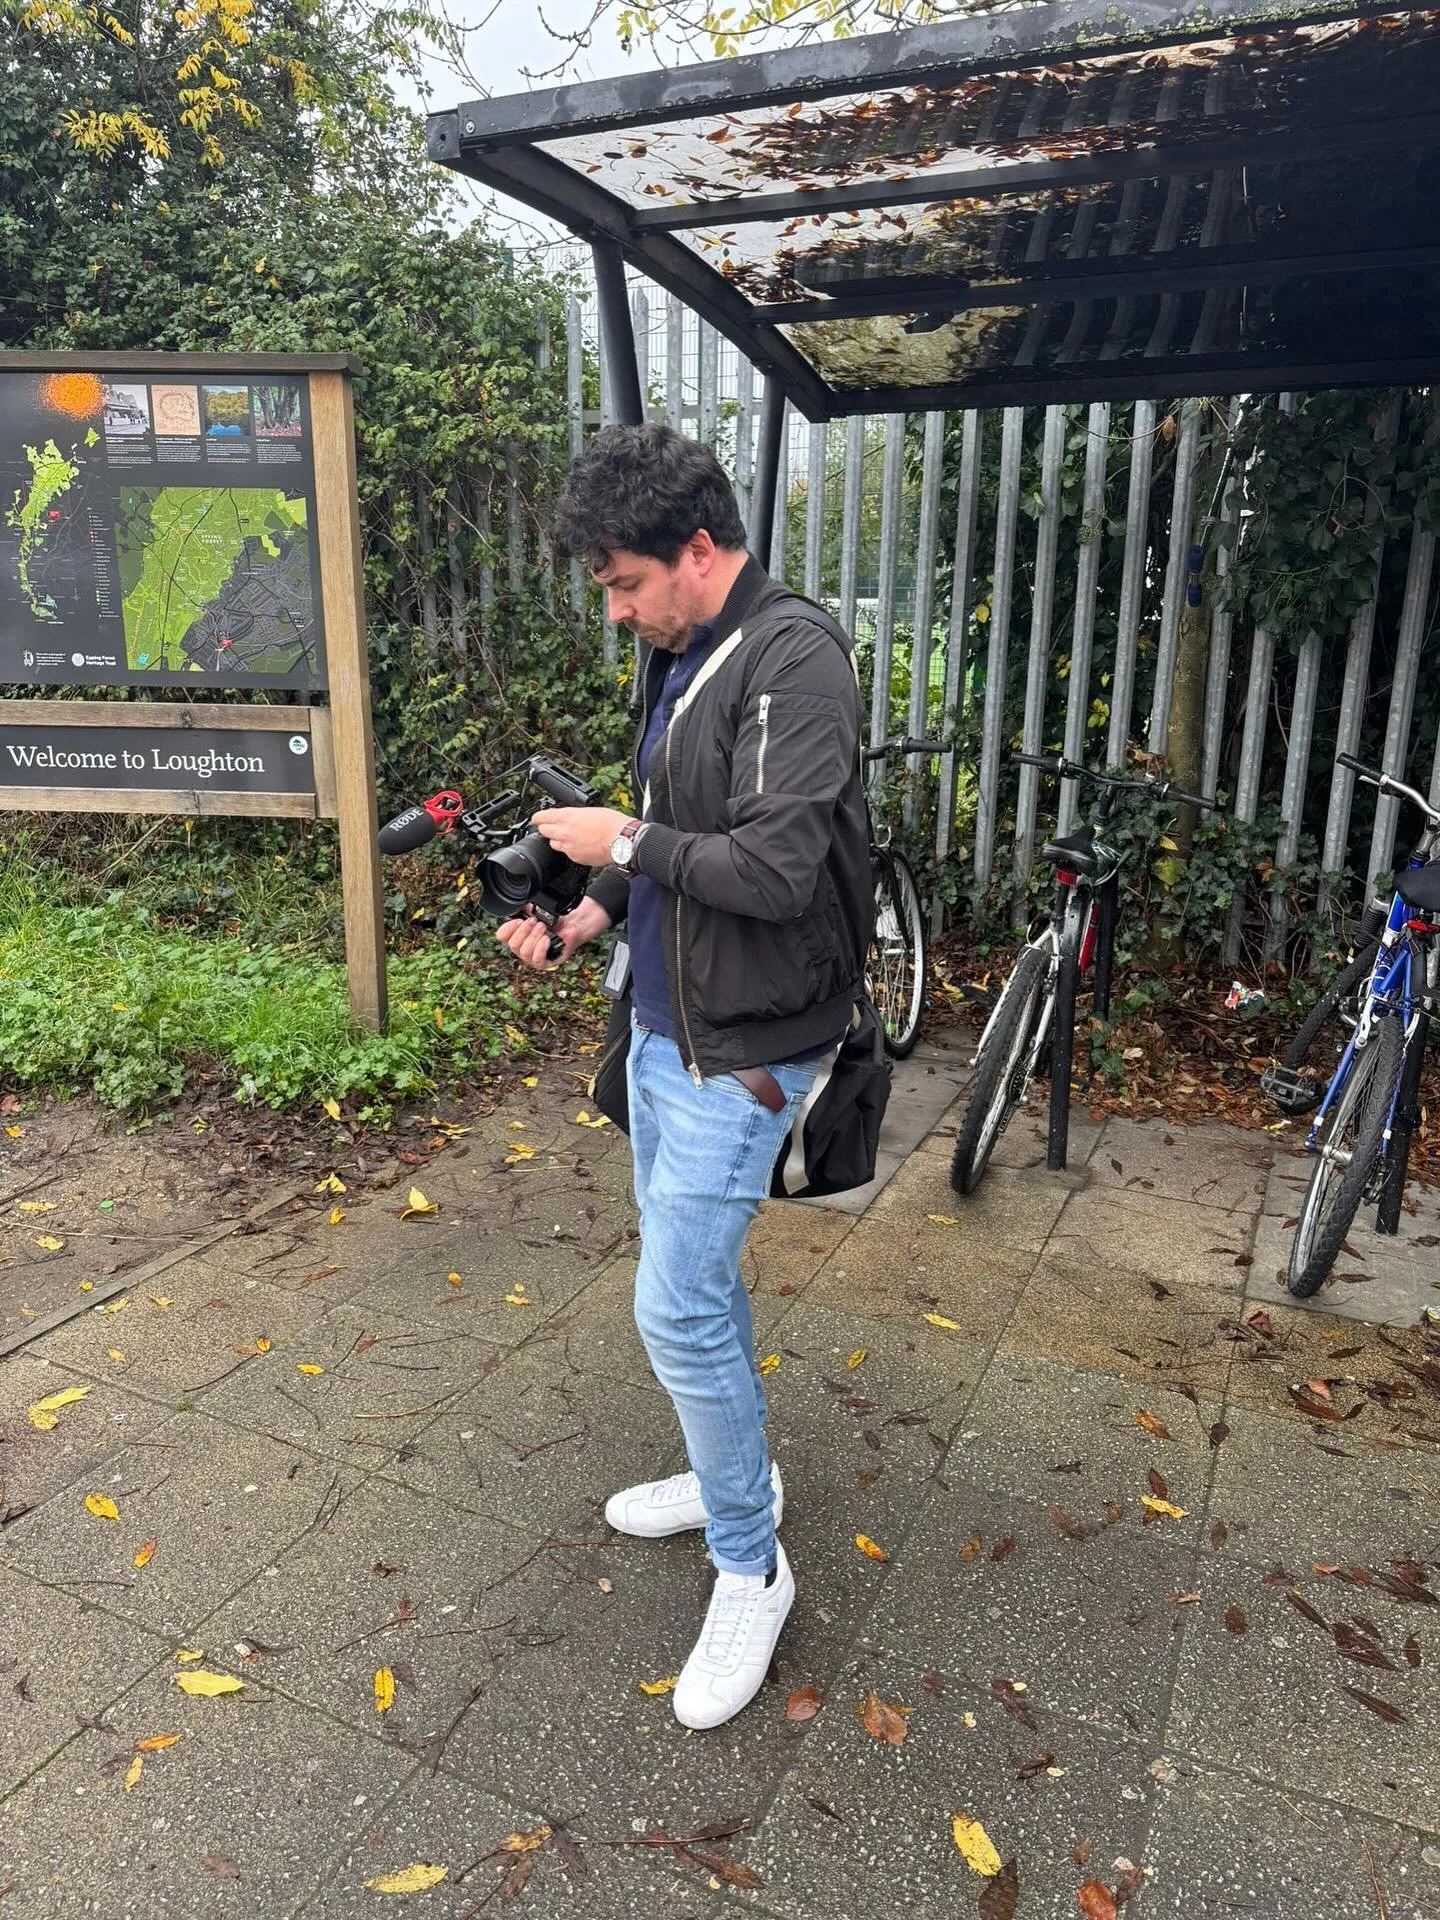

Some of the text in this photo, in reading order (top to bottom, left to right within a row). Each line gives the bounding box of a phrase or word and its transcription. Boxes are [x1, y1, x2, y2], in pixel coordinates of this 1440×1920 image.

[6, 745, 265, 778] Welcome to Loughton
[389, 808, 424, 832] RØDE
